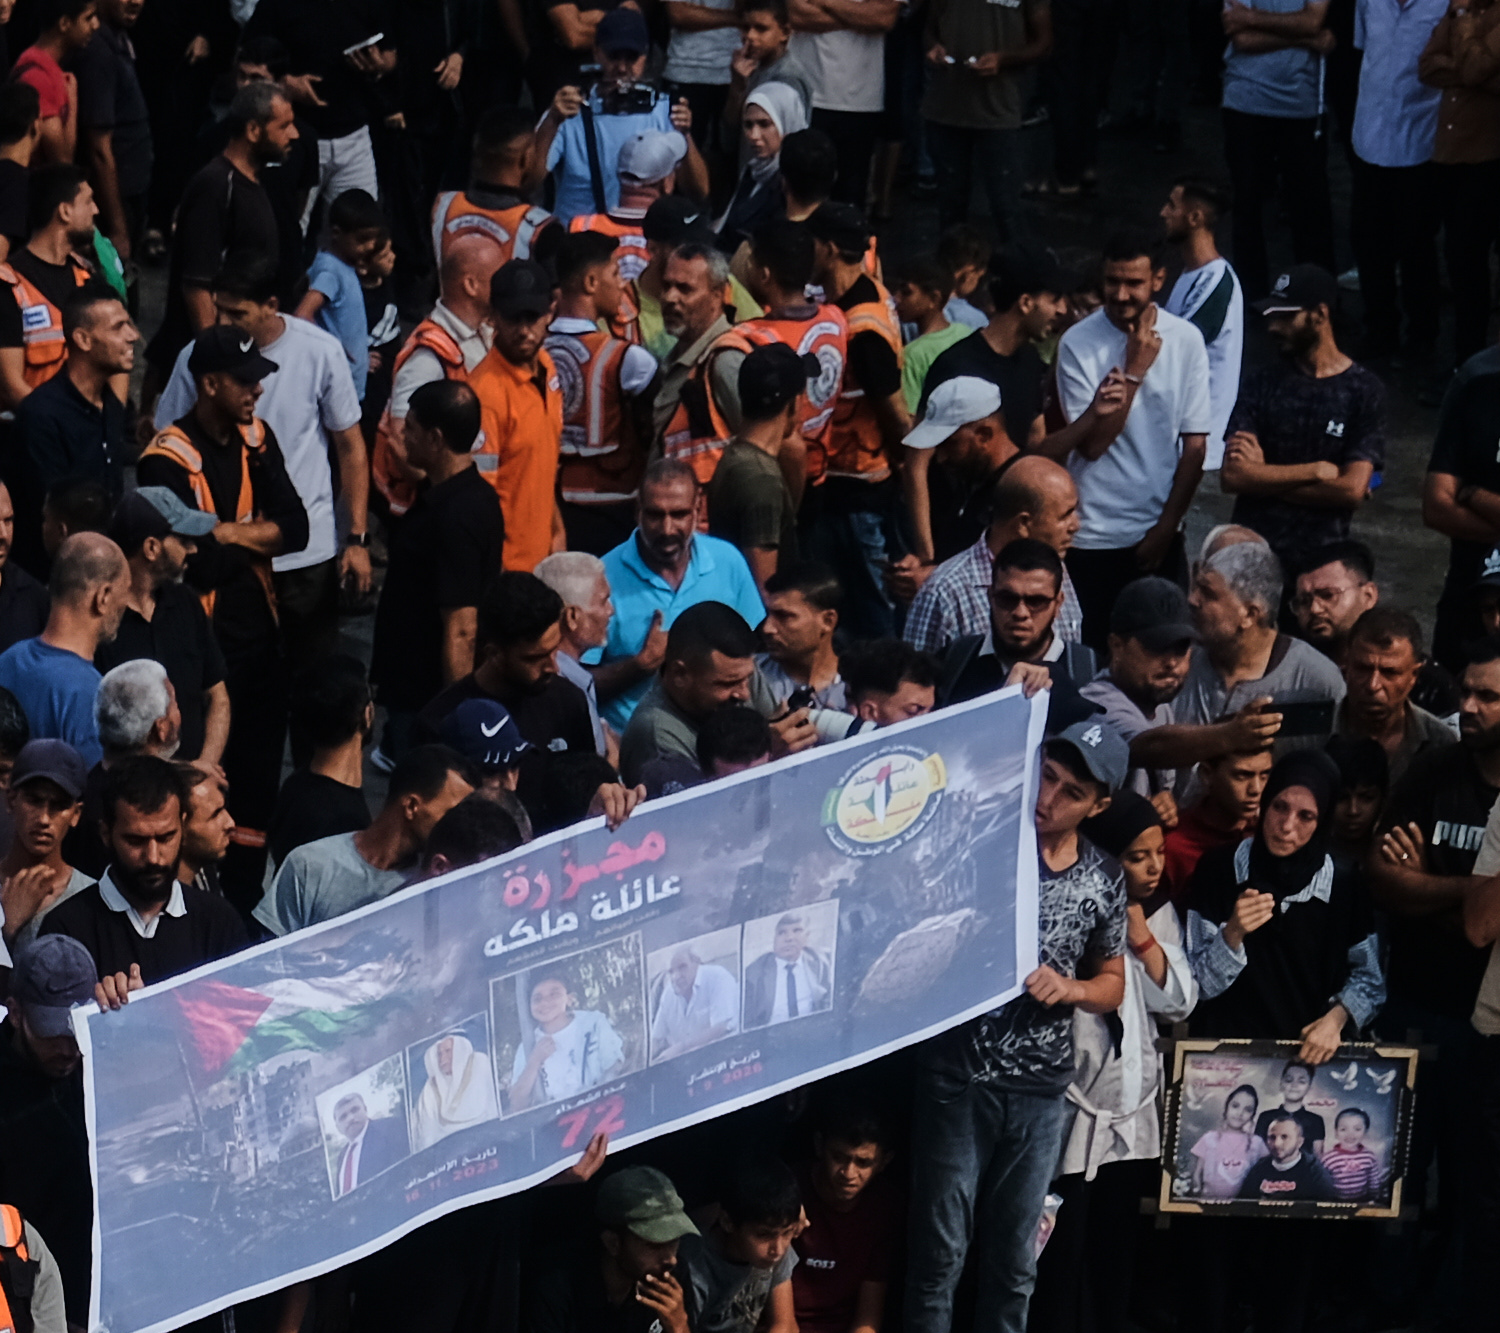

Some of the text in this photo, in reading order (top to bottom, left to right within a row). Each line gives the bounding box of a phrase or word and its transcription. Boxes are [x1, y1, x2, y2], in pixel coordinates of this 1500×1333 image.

[502, 831, 666, 911] مجزرة
[590, 872, 682, 922] عائلة
[558, 1094, 626, 1148] 72
